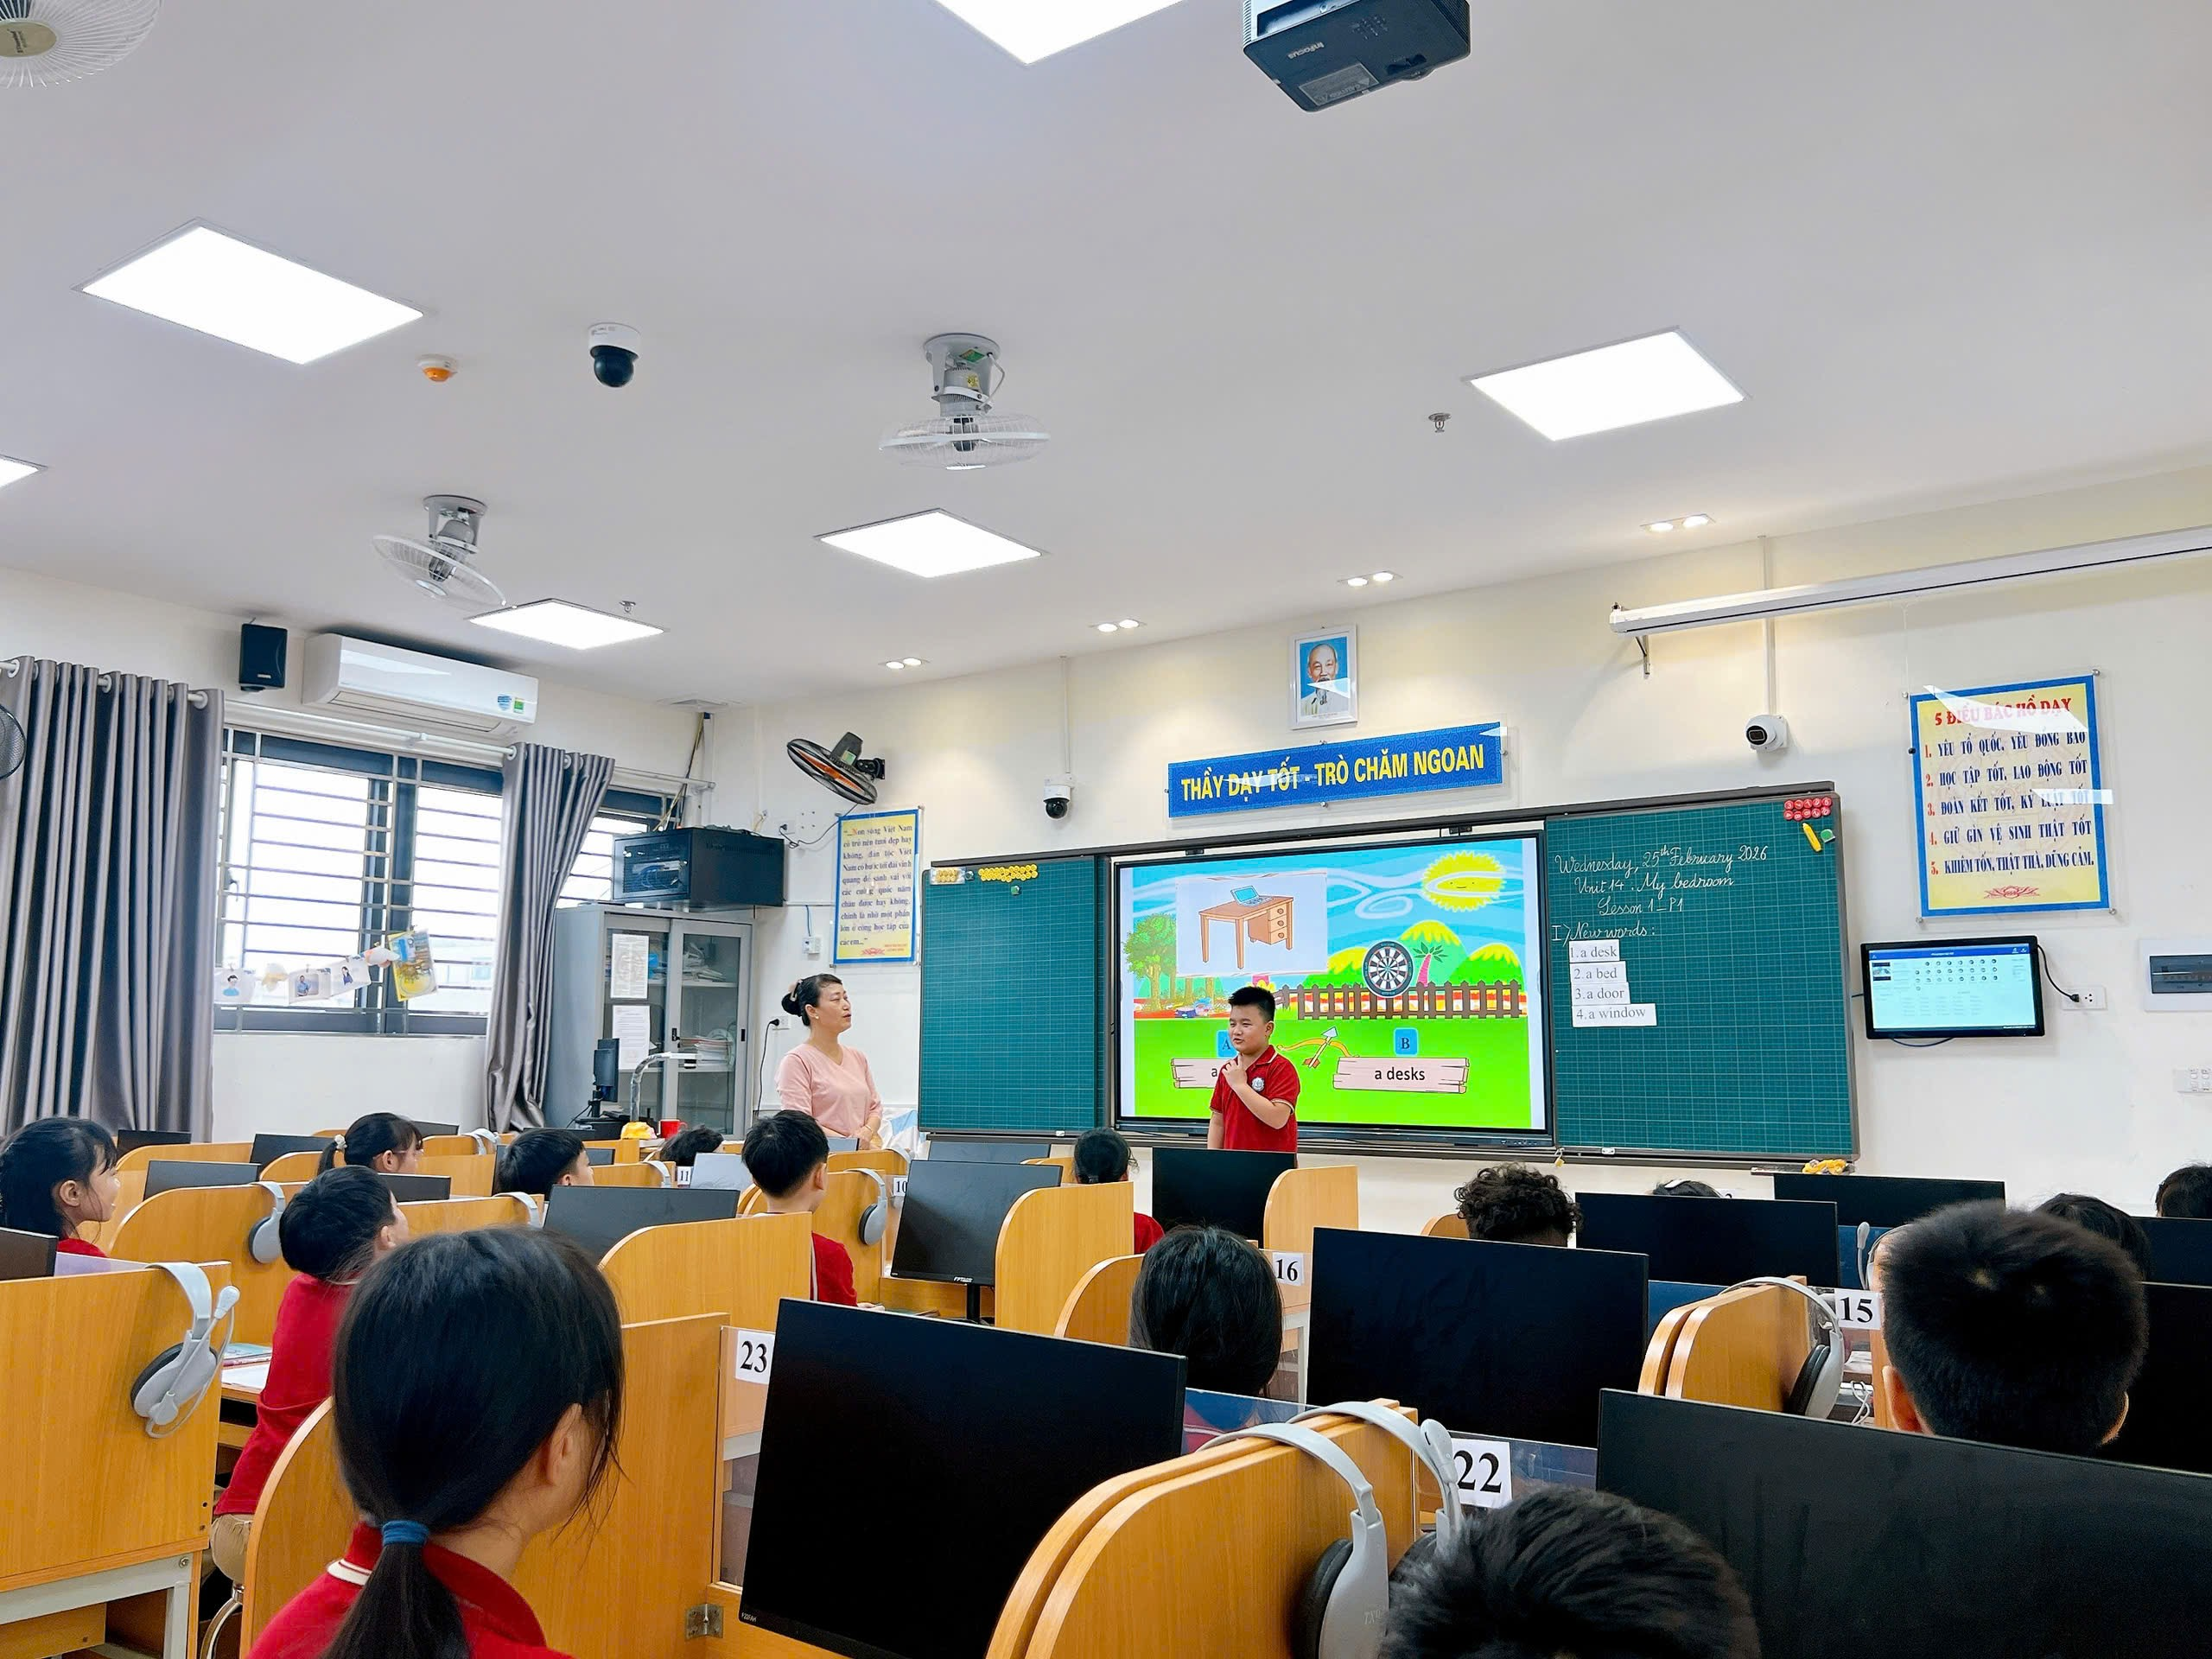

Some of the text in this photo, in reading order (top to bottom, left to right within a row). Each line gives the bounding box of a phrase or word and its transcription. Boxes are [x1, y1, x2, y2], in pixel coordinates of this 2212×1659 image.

[1935, 712, 1942, 726] 5
[1983, 701, 2012, 721] BÁC
[2016, 694, 2037, 719] HỒ
[2040, 697, 2071, 718] DẠY
[1924, 744, 1932, 759] 1.
[1937, 738, 1955, 757] YÊU
[1960, 732, 1973, 754] TỔ
[2011, 731, 2028, 750] YÊU
[1181, 766, 1224, 802] THẦY
[1228, 770, 1263, 803] DẠY
[1268, 756, 1300, 792] TỐT
[1314, 754, 1349, 786] TRÒ
[1354, 748, 1408, 783] CHĂM
[1414, 744, 1484, 776] NGOAN
[1925, 773, 1934, 787] 2.
[1939, 772, 1956, 791] HỌC
[1962, 766, 1980, 788] TẬP
[2013, 765, 2031, 779] LAO
[2037, 759, 2062, 782] ĐỘNG
[2069, 753, 2088, 775] TỐT
[1927, 802, 1936, 816] 3.
[1941, 796, 1964, 816] ĐOÀN
[1970, 791, 1988, 813] KẾT
[1929, 813, 2092, 846] 4. GIỮ GÌN VỆ SINH THẬT TỐT
[1554, 852, 1639, 879] Wednesday,
[1669, 847, 1733, 874] February
[1738, 844, 1769, 861] 2026
[1930, 861, 1939, 875] 5.
[1944, 855, 1973, 874] KHIÊM
[1996, 852, 2020, 875] THẬT
[2045, 849, 2069, 869] DŨNG
[1573, 876, 1607, 894] Unit
[1608, 879, 1624, 892] 14
[1637, 872, 1666, 900] My
[1670, 871, 1735, 889] bedroom
[1598, 895, 1643, 916] Lesson
[1570, 920, 1605, 940] New
[1590, 945, 1618, 958] desk
[1596, 967, 1618, 979] bed
[1597, 988, 1624, 1000] door
[1599, 1007, 1646, 1019] window
[1222, 1039, 1230, 1050] A
[1401, 1037, 1410, 1050] B
[1211, 1067, 1218, 1077] a
[1374, 1066, 1426, 1081] a desks
[897, 1180, 908, 1193] 10
[1274, 1257, 1299, 1281] 16
[1840, 1296, 1874, 1325] 15
[740, 1340, 768, 1374] 23
[1455, 1451, 1503, 1493] 22
